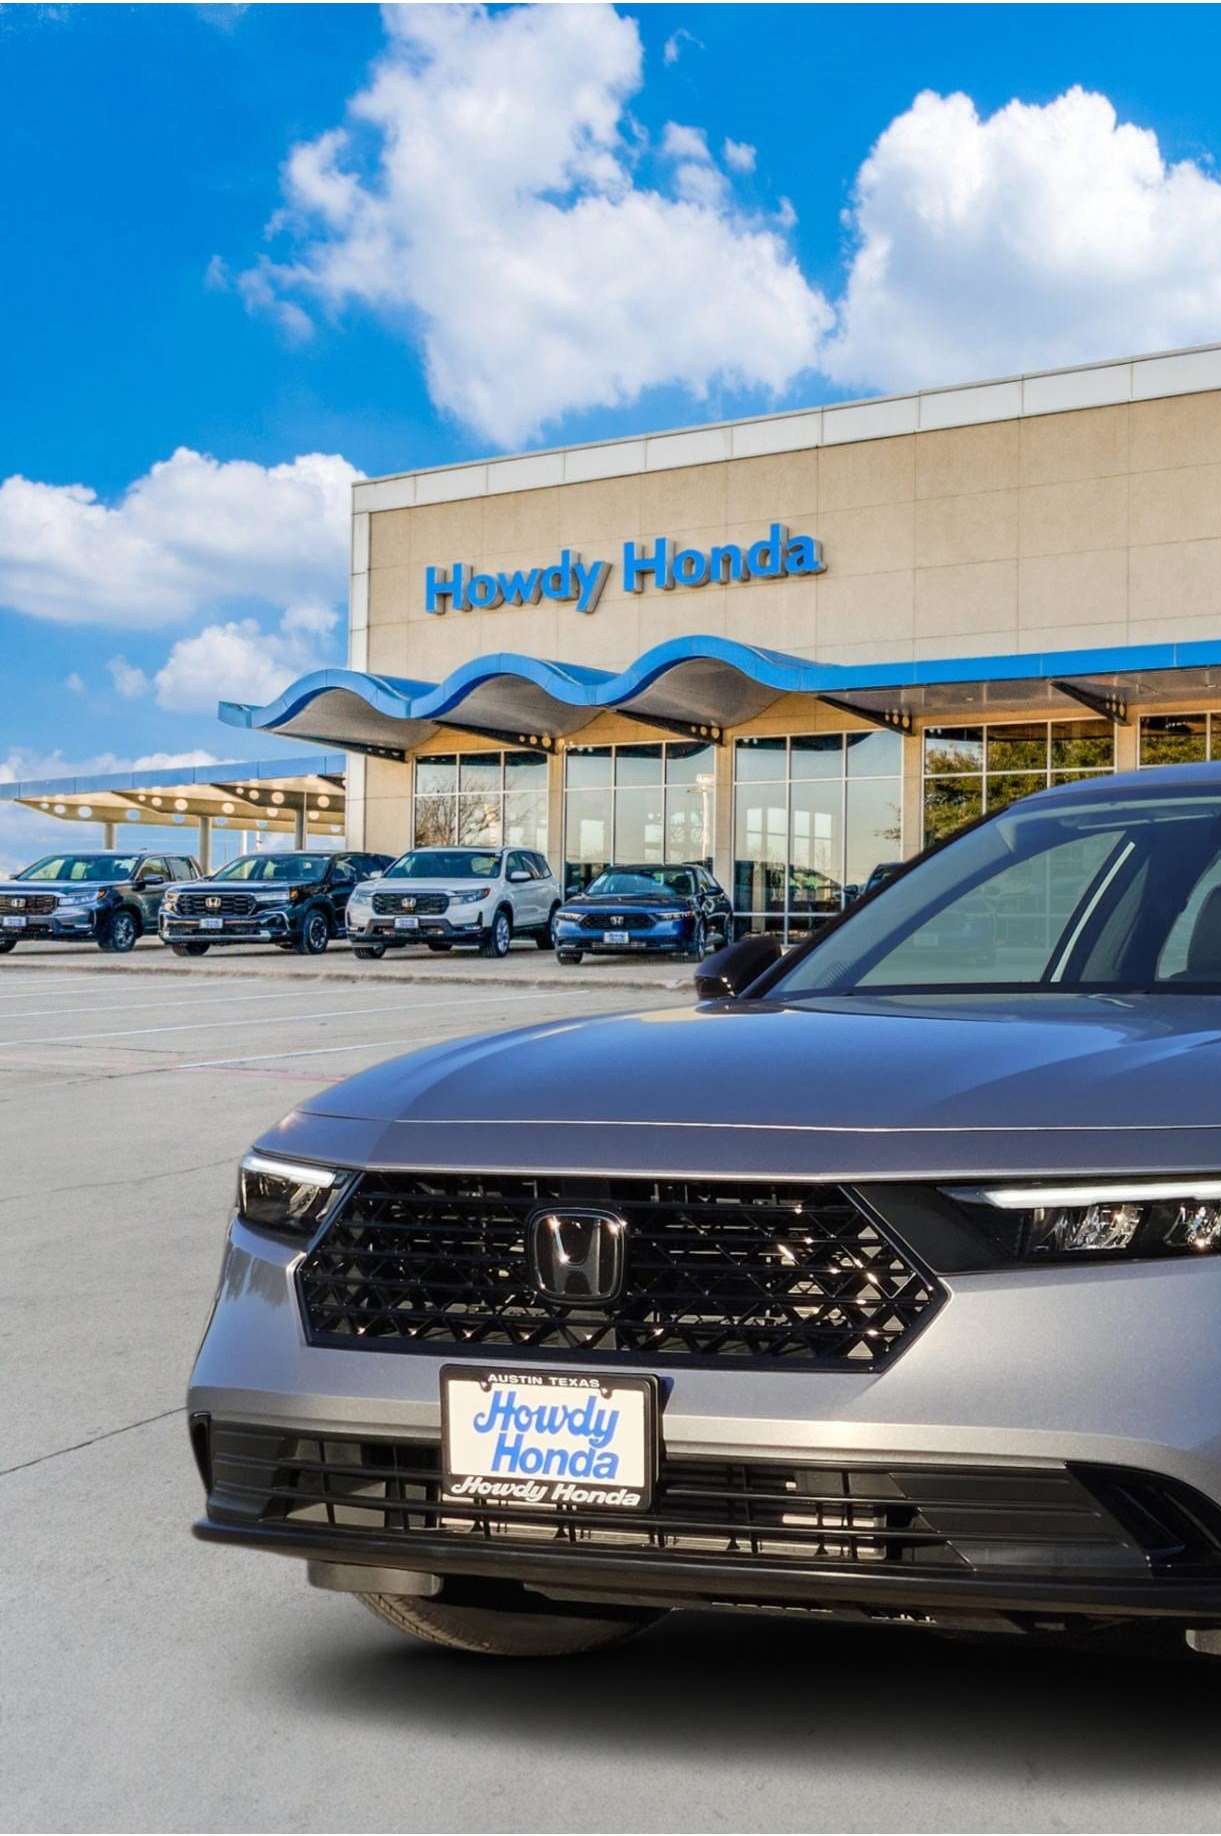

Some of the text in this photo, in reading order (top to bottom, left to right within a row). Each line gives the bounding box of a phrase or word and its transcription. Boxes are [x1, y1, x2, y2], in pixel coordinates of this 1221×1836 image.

[425, 523, 826, 614] Howdy Honda
[487, 1373, 600, 1388] AUSTIN TEXAS
[473, 1390, 619, 1448] Howdy
[491, 1433, 620, 1480] Honda
[451, 1476, 641, 1506] Howdy Honda
